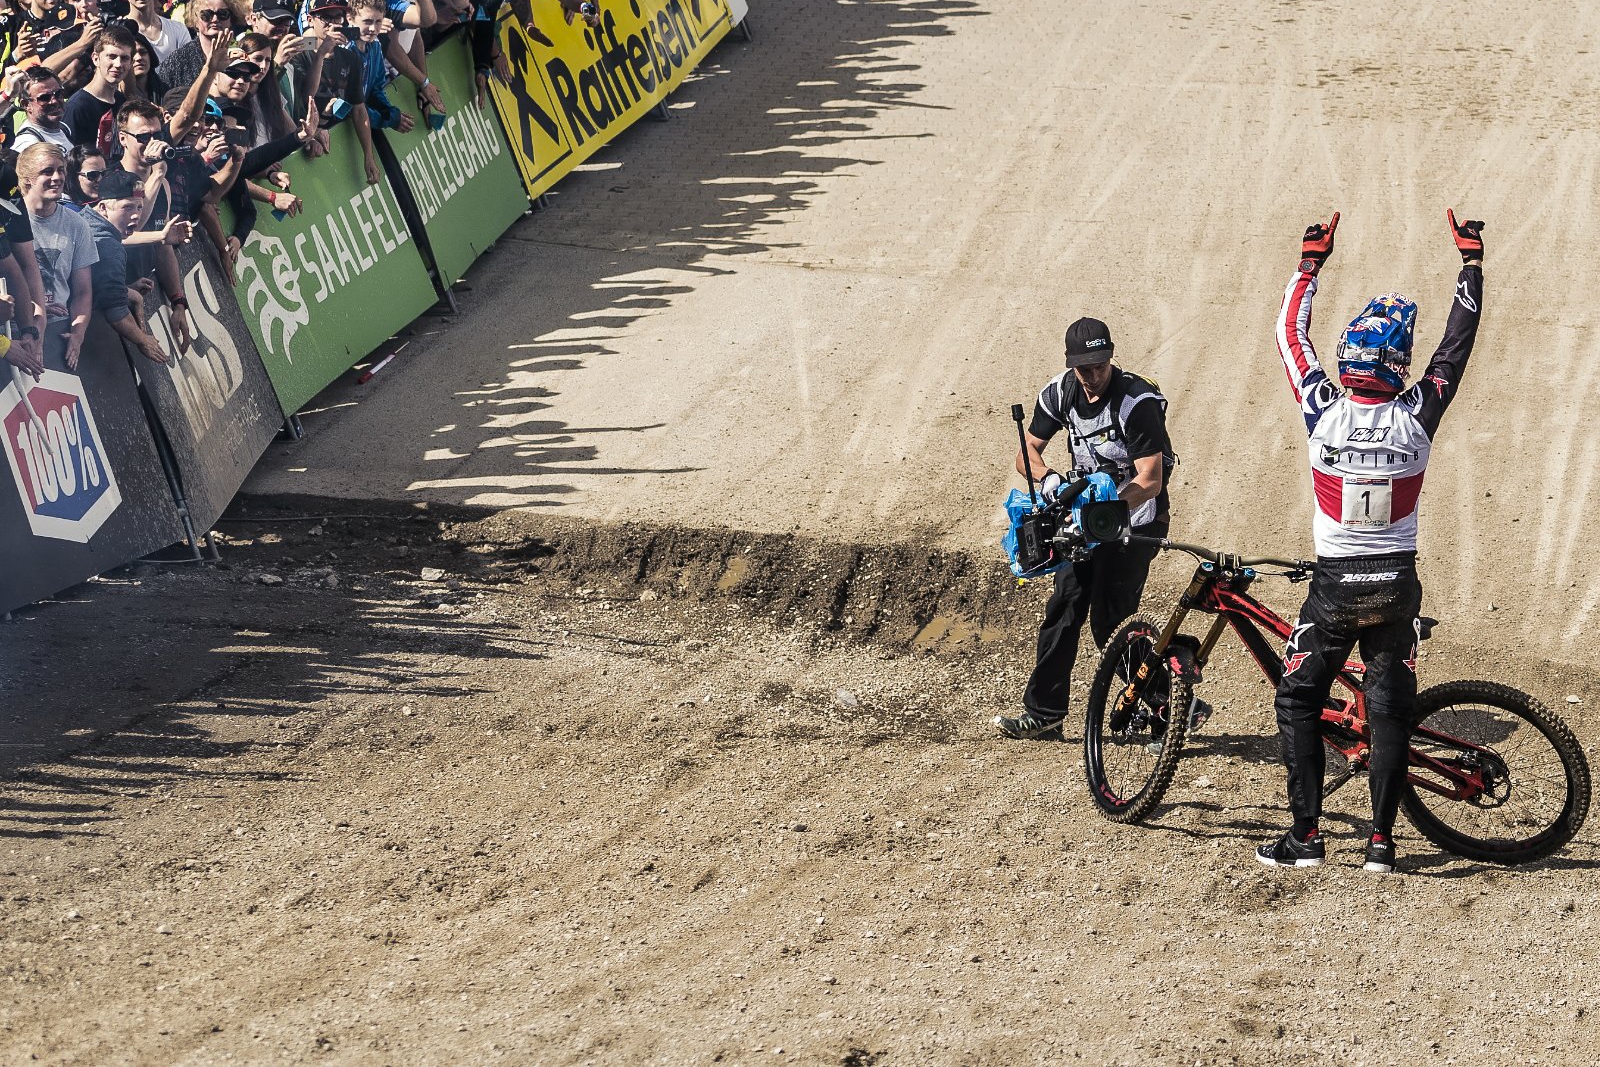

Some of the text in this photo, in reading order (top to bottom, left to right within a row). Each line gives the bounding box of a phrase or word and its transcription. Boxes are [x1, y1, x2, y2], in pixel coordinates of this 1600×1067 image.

[17, 401, 101, 505] 100%
[1347, 450, 1420, 465] YT MOB
[1361, 490, 1371, 518] 1
